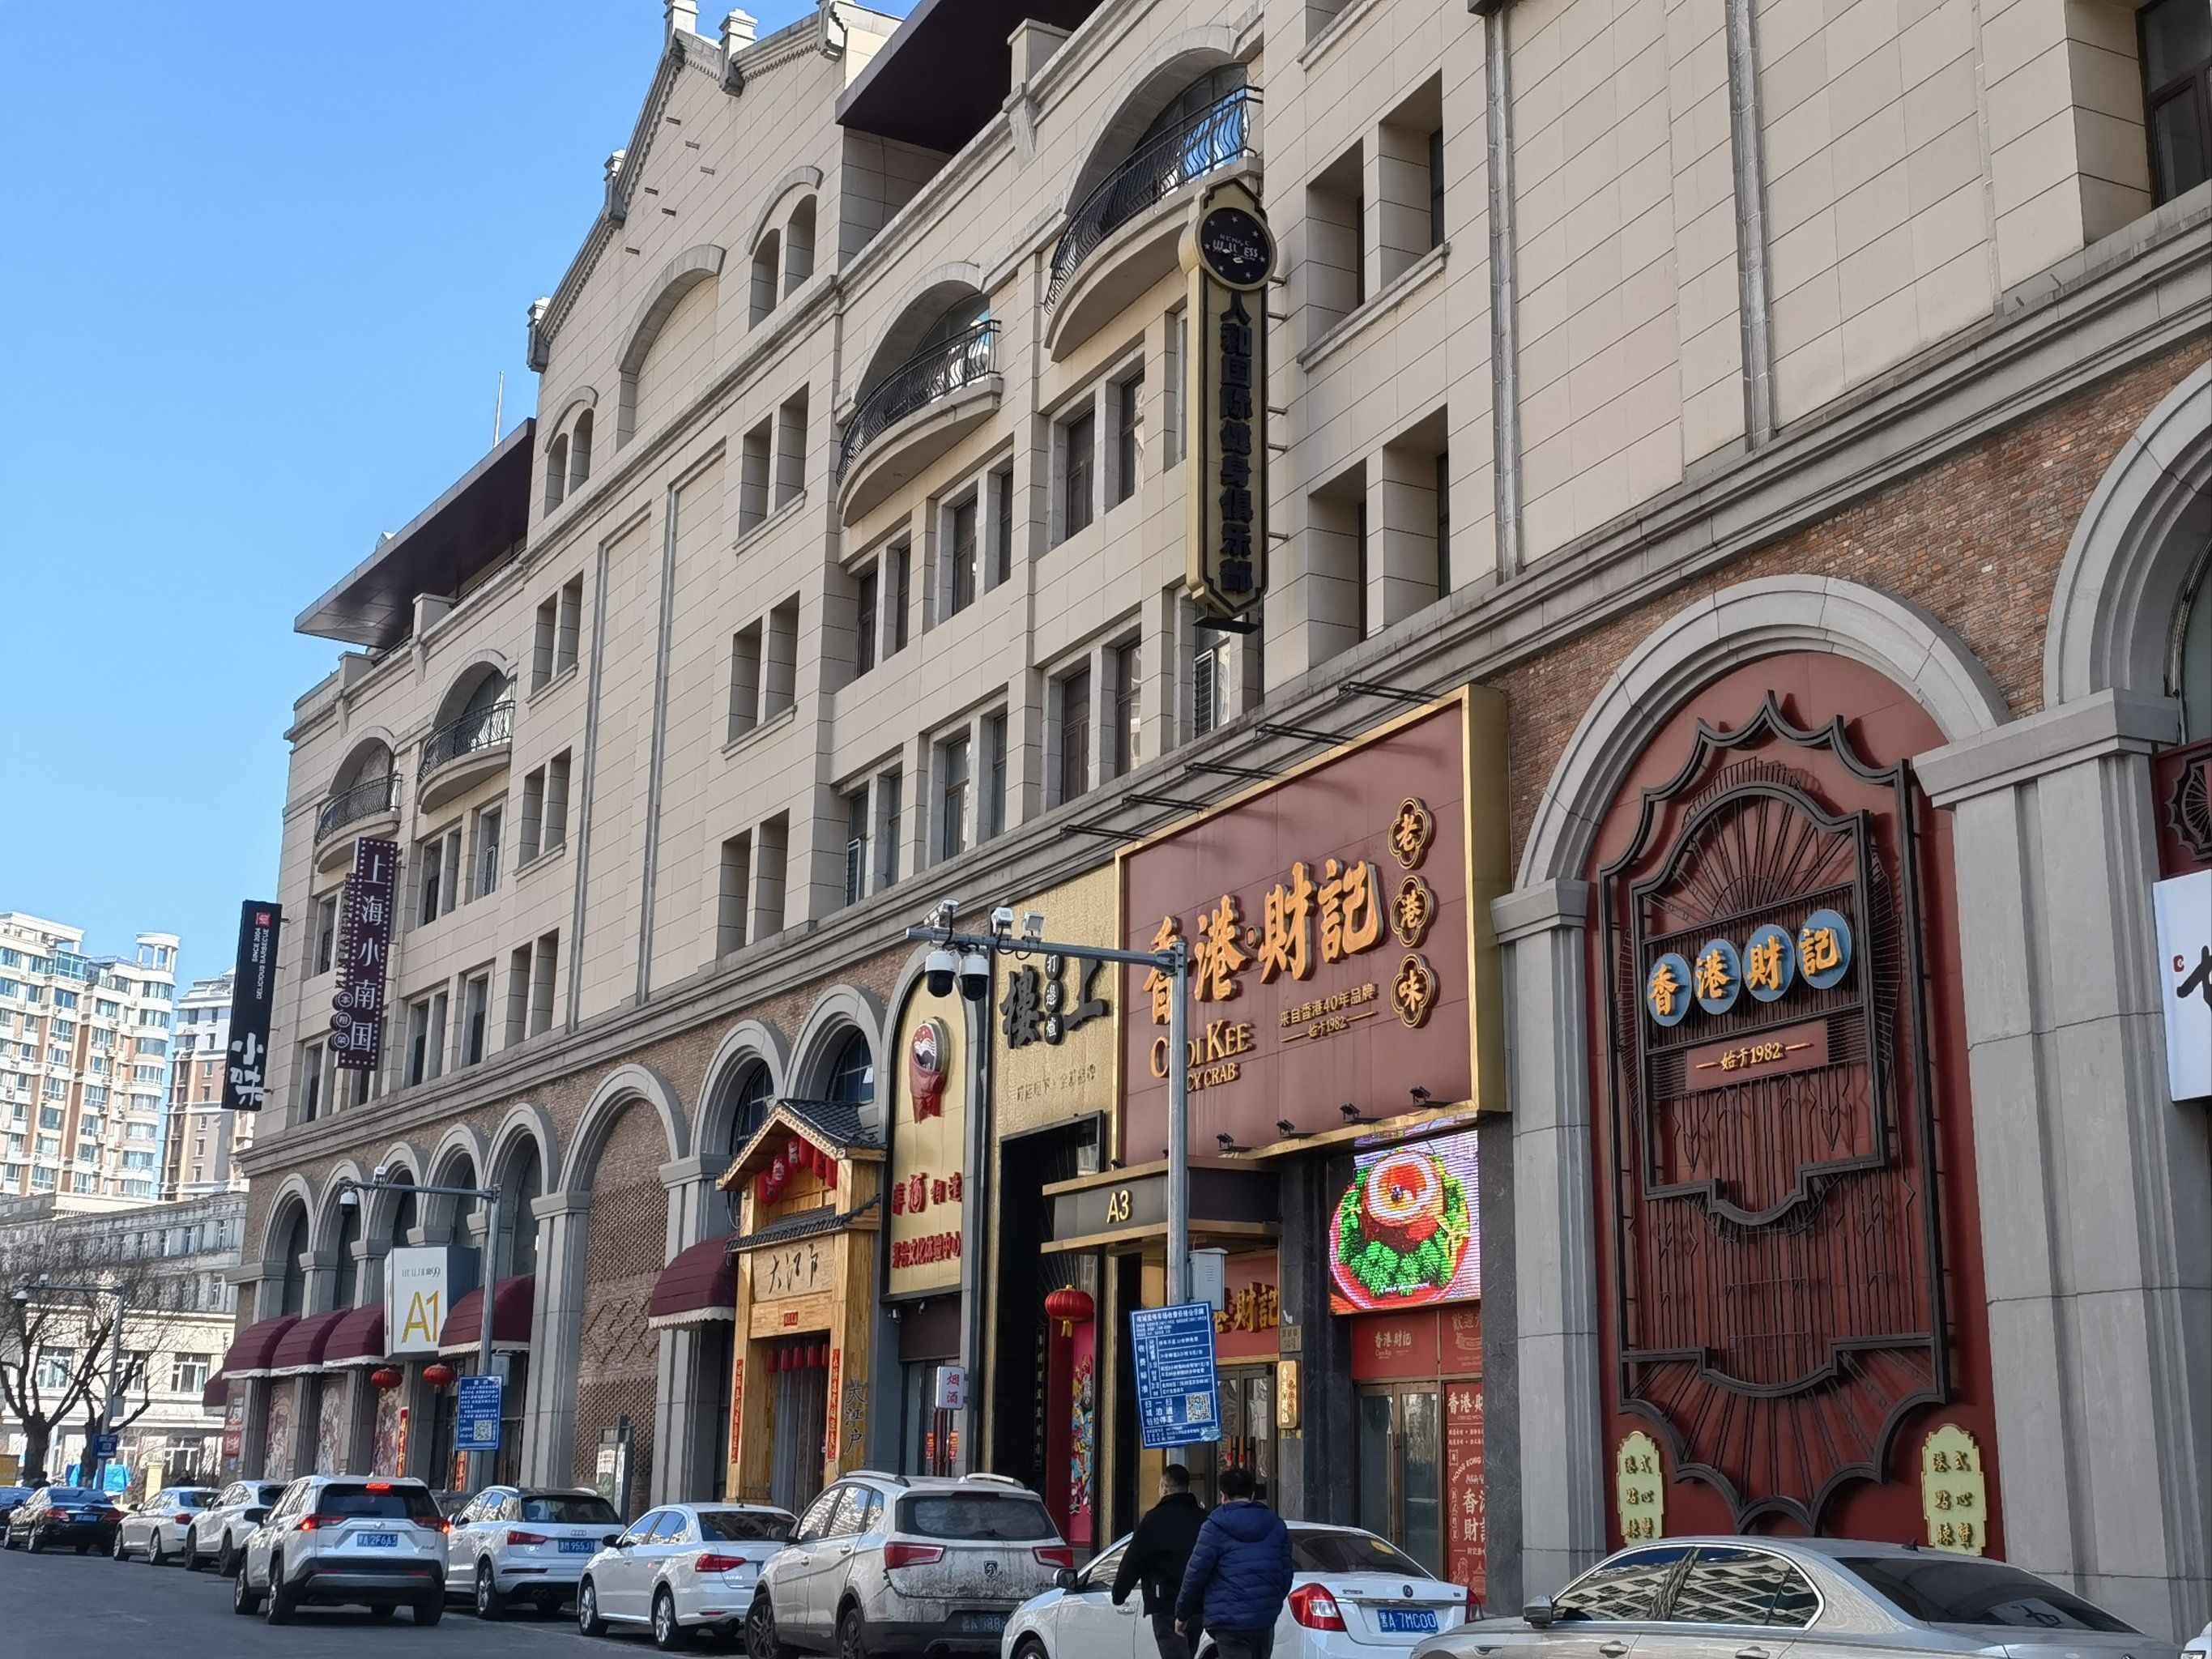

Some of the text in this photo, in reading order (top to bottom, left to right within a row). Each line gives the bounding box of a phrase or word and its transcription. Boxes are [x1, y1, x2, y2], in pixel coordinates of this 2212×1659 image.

[1220, 290, 1253, 595] 人和国际健身俱乐部
[1395, 812, 1425, 1013] 老港味
[251, 943, 260, 963] SINCE
[259, 928, 270, 964] BARBECUE
[350, 855, 387, 1052] 上海小南国
[256, 965, 266, 1000] DELICIOUS
[1650, 927, 1843, 1016] 香港財記
[1280, 983, 1376, 1027] 来自香港40年品牌
[1206, 1019, 1253, 1062] KEE
[1720, 1042, 1784, 1072] 始于1982
[1204, 1062, 1238, 1087] CRAB
[1106, 1189, 1130, 1223] A3
[400, 1290, 439, 1344] A1
[946, 1371, 961, 1405] 烟酒
[1144, 1397, 1173, 1409] 扫一扫
[1451, 1463, 1466, 1484] HONG
